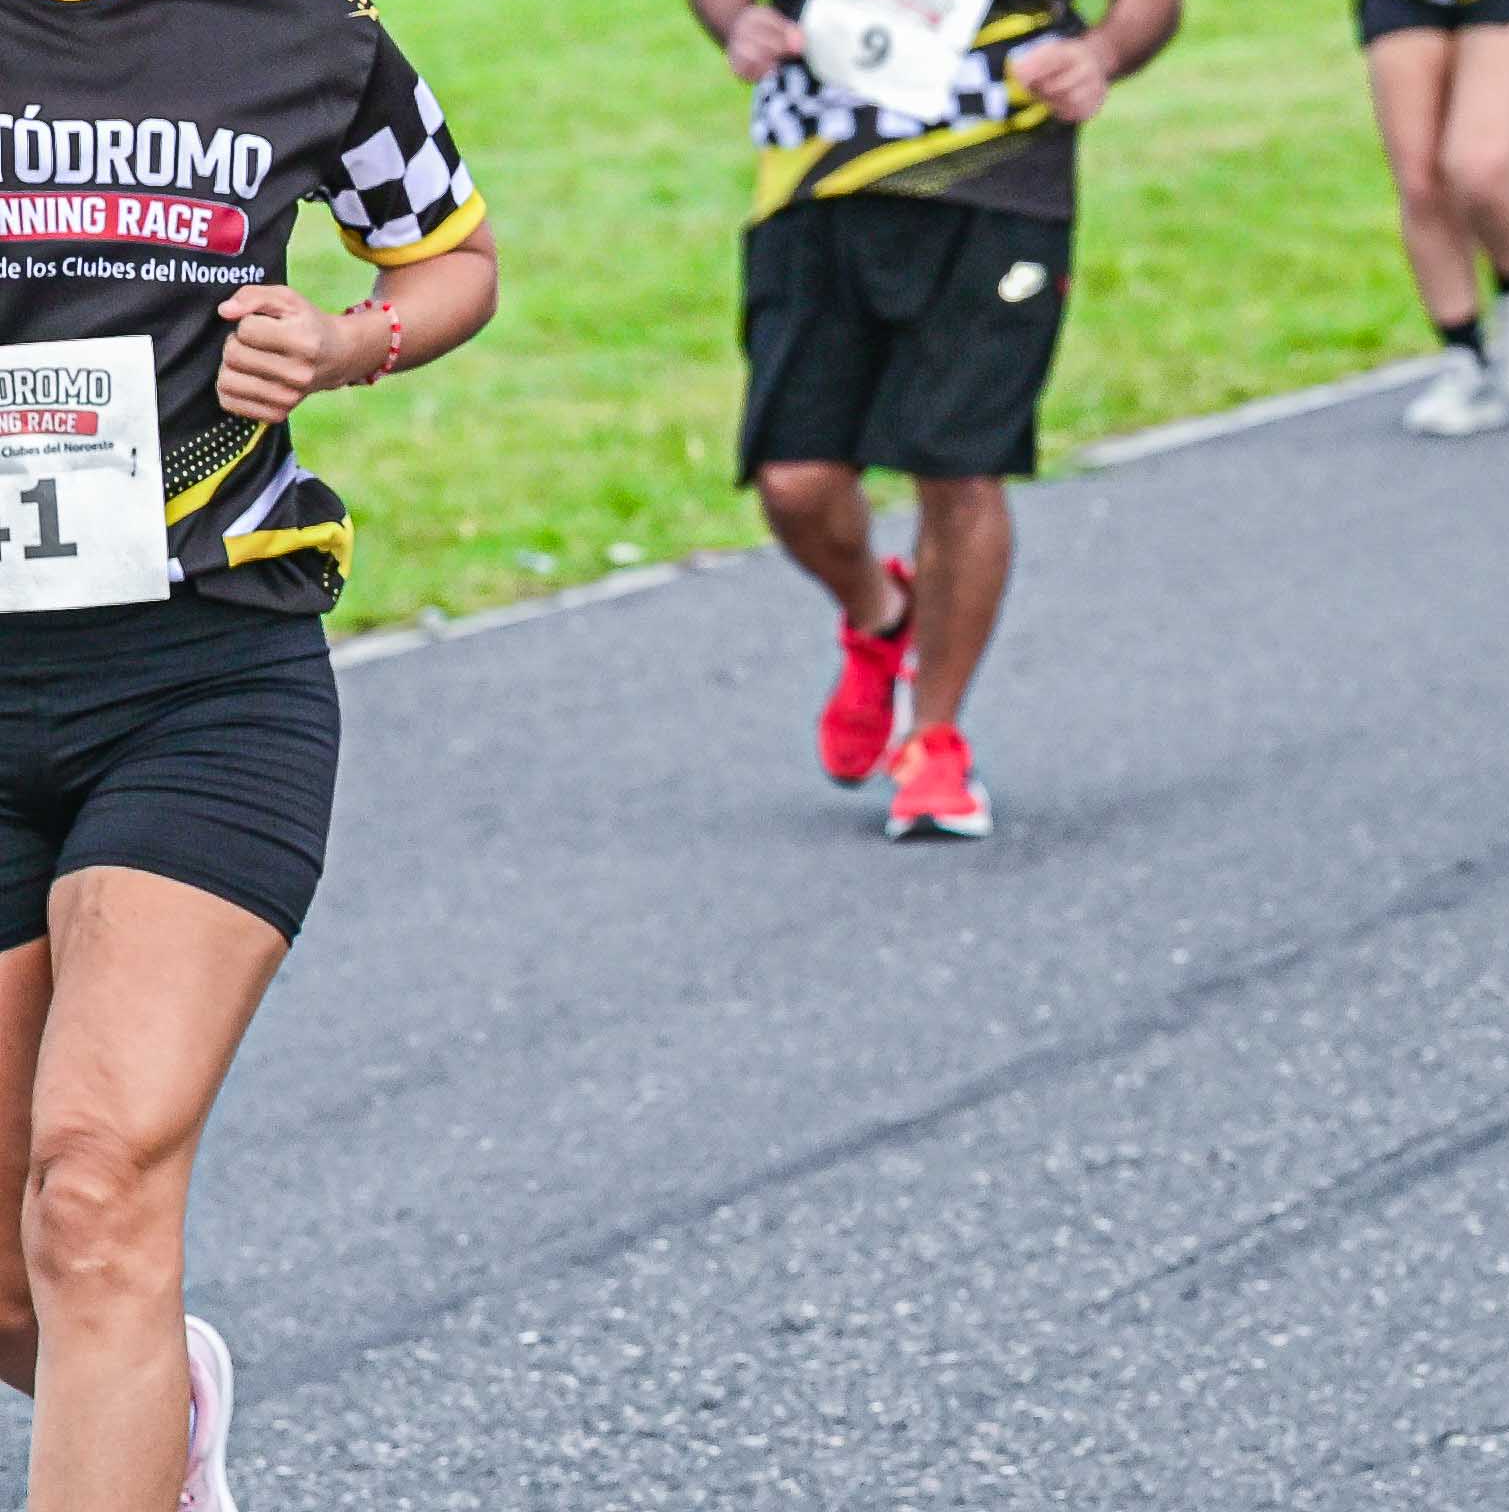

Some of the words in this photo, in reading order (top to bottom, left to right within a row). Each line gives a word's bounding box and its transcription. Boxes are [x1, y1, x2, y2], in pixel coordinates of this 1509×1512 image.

[854, 26, 893, 71] 9
[0, 104, 273, 199] ÓDROMO
[117, 199, 213, 247] RACE
[27, 256, 57, 278] los
[62, 257, 136, 280] Clubes
[141, 259, 176, 283] del
[181, 261, 265, 284] Noroeste
[28, 412, 78, 433] RACE
[1, 445, 40, 458] Clubes
[43, 443, 61, 455] del
[63, 440, 115, 453] Noroeste
[0, 478, 78, 559] 1
